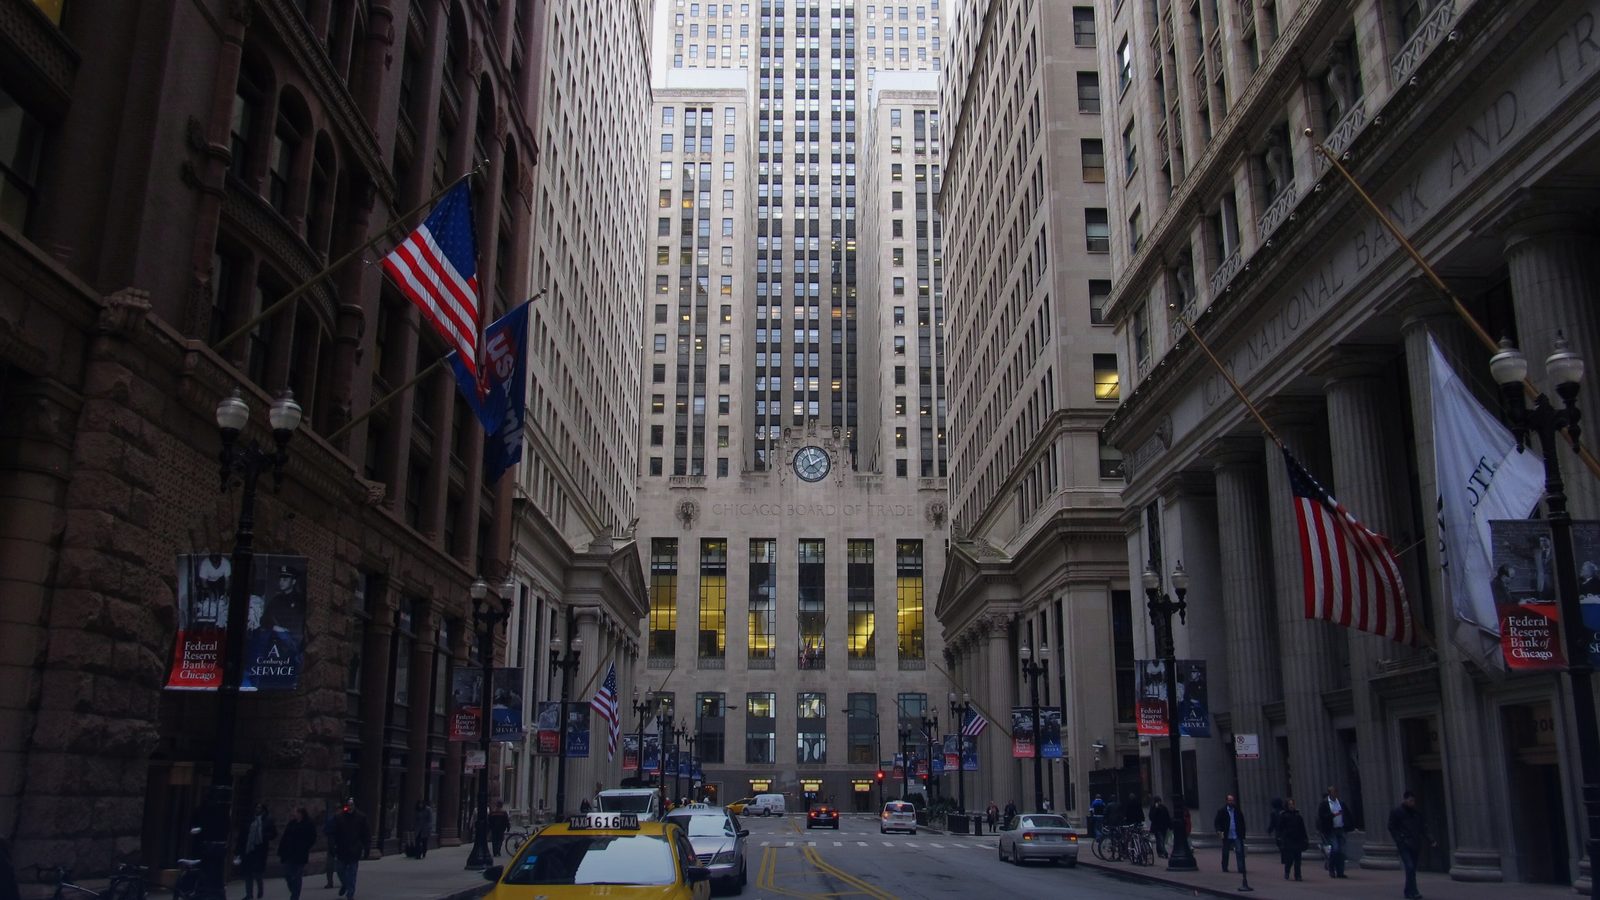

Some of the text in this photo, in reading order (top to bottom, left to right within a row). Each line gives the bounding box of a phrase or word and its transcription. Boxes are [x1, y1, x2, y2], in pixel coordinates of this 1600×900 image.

[1246, 260, 1343, 370] NATIONAL
[1353, 174, 1427, 272] BANK
[1448, 91, 1516, 188] AND
[712, 503, 914, 516] CHICAGO BOARD OF TRADE
[1508, 616, 1548, 627] Federal
[1510, 627, 1550, 637] Reserve
[184, 641, 218, 651] Federal
[1511, 637, 1551, 650] Bank of
[183, 651, 217, 660] Reserve
[267, 644, 280, 658] A
[1512, 648, 1553, 660] Chicago
[182, 660, 217, 672] Bank of
[249, 665, 295, 676] SERVICE
[179, 669, 216, 681] Chicago
[503, 715, 511, 723] A
[1190, 709, 1197, 718] A
[570, 816, 638, 828] TAXI 1616 TAXI
